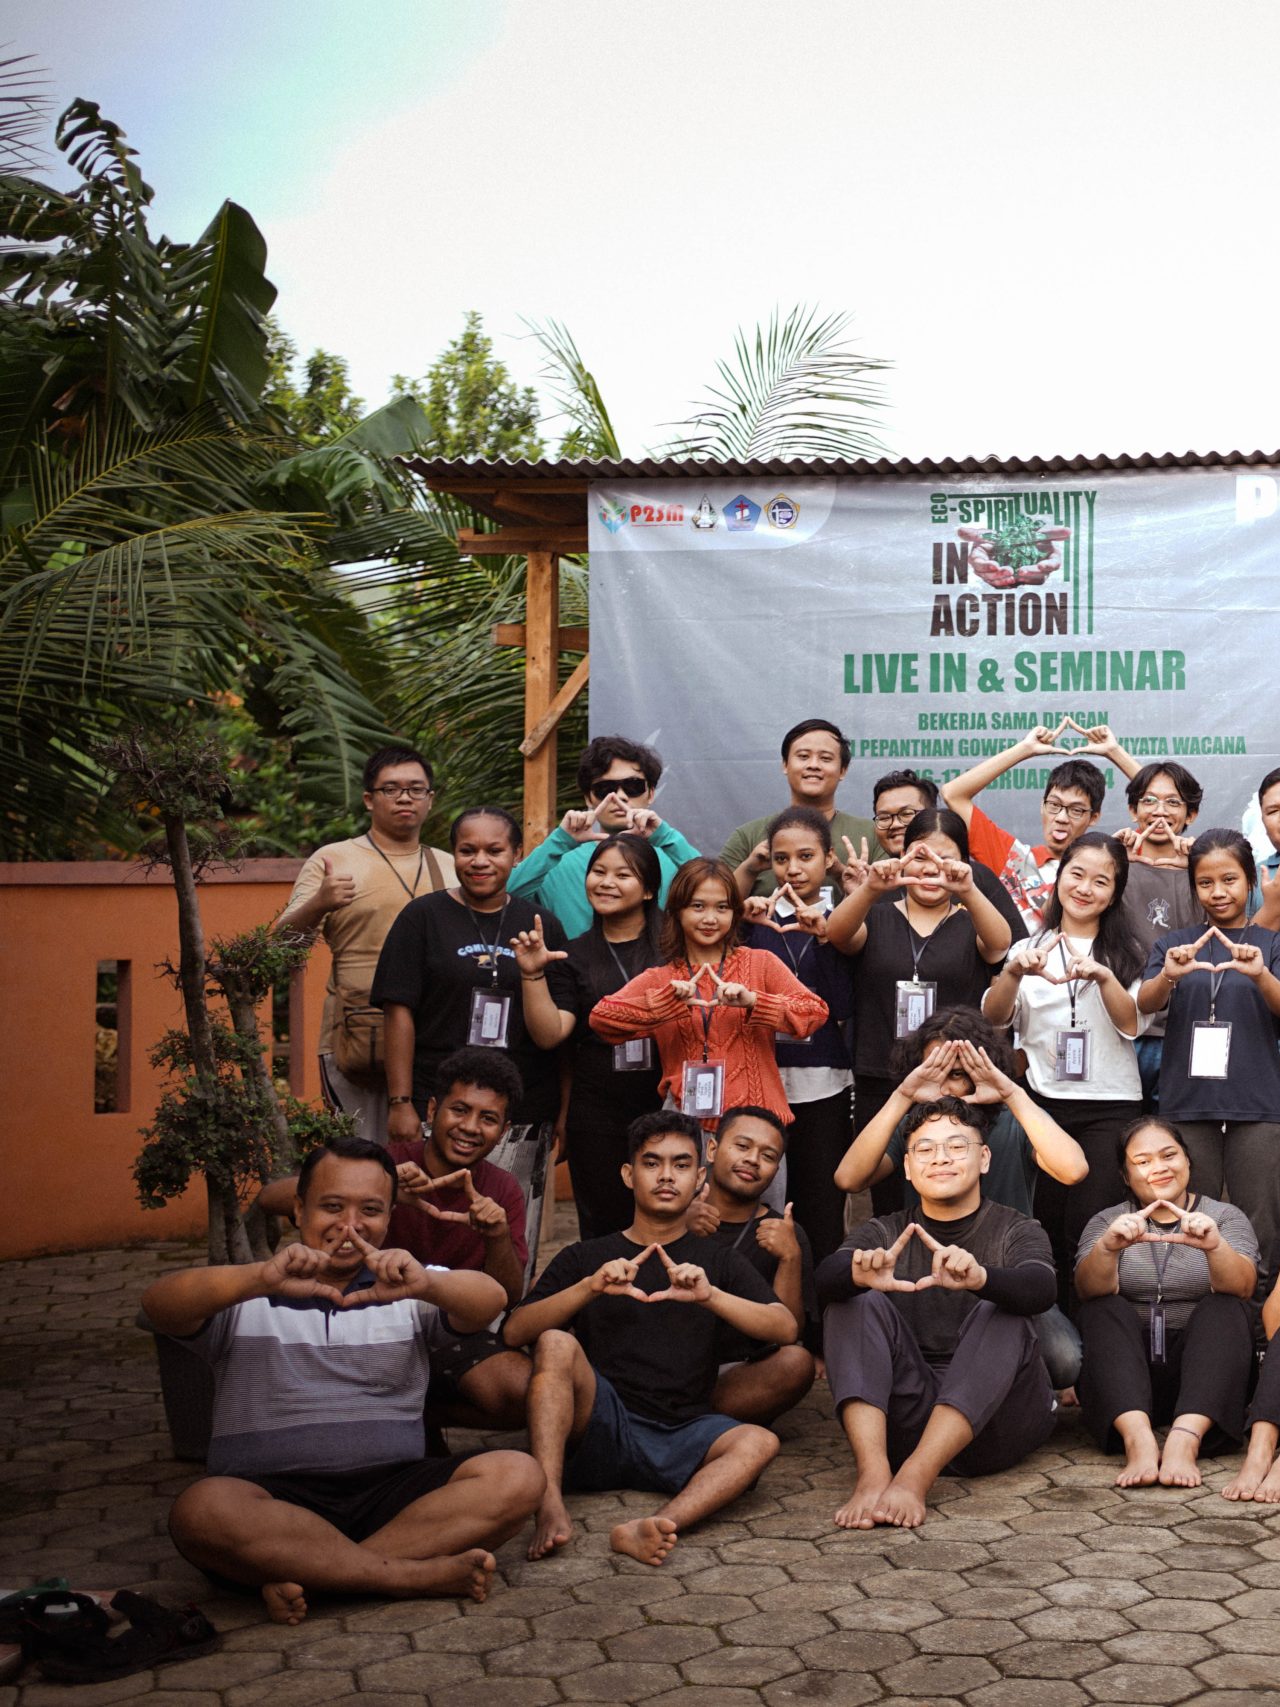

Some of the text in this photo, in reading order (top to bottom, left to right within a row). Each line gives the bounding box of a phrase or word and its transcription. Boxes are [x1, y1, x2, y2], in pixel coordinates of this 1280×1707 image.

[630, 505, 684, 522] P2SM
[930, 493, 948, 523] ECO
[932, 542, 968, 584] IN
[930, 592, 1068, 637] ACTION
[844, 650, 1186, 693] LIVE IN & SEMINAR
[918, 711, 1109, 730] BEKERJA SAMA DENGAN
[860, 739, 953, 757] PEPANTHAN
[1172, 736, 1247, 754] WACANA
